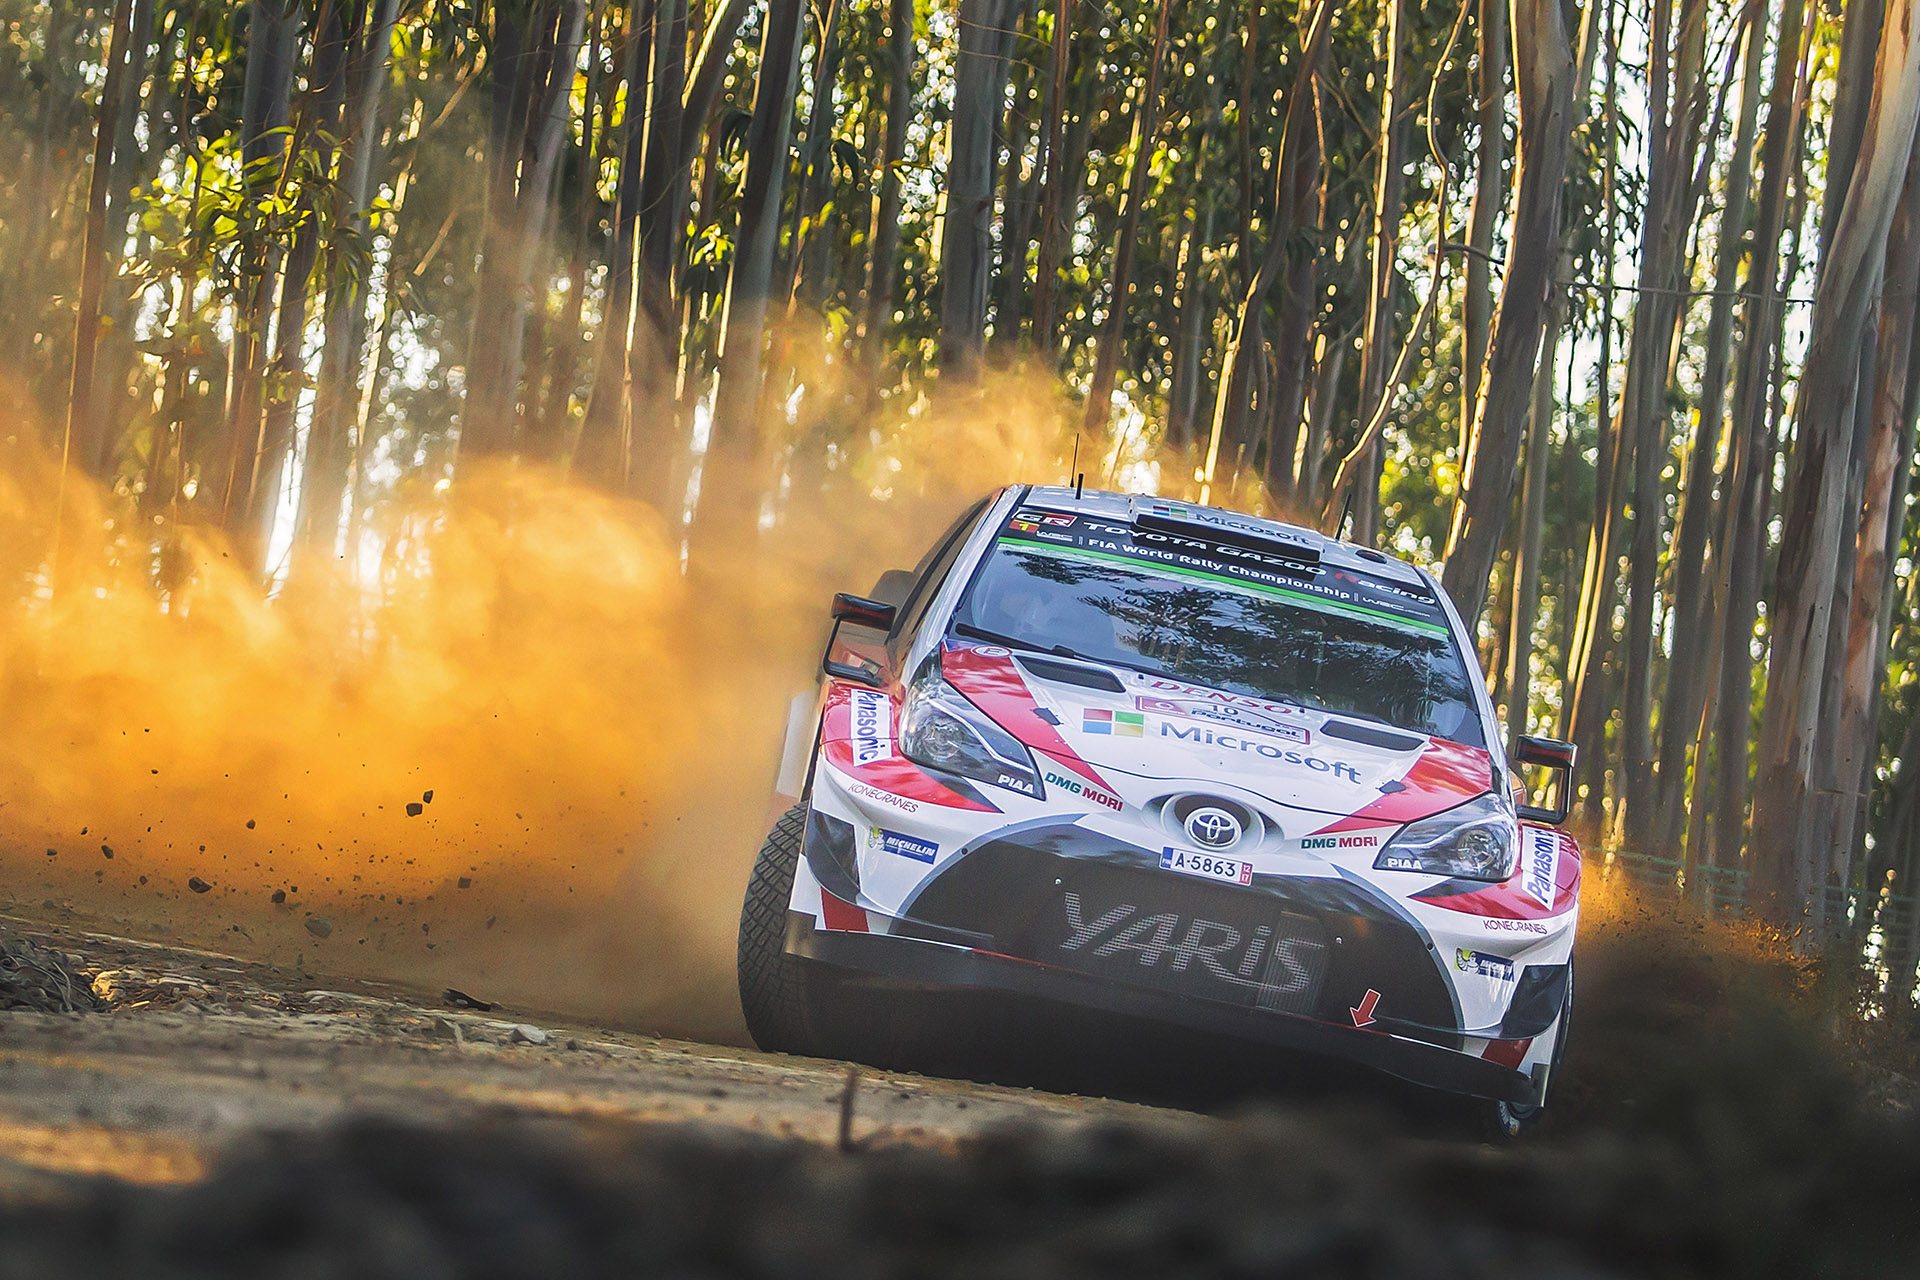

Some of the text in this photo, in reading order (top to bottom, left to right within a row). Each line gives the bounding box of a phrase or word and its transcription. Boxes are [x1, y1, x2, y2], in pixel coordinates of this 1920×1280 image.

[1016, 511, 1072, 528] GR
[1196, 513, 1310, 546] Microsoft
[1083, 521, 1436, 605] TOYOTA GAZOO Racing
[1088, 538, 1351, 600] FIA World Rally Championship
[1151, 681, 1292, 714] DENSO
[856, 689, 886, 762] Panasonic
[1160, 721, 1362, 785] Microsoft
[847, 782, 919, 814] KONECRANES
[997, 774, 1035, 795] PIAA
[1044, 771, 1124, 812] DMG MORI
[886, 836, 936, 858] MICHELIN
[1300, 836, 1378, 849] DMG MORI
[1174, 852, 1236, 878] A-5863
[1387, 857, 1423, 870] PIAA
[1482, 919, 1549, 935] KONECRANES
